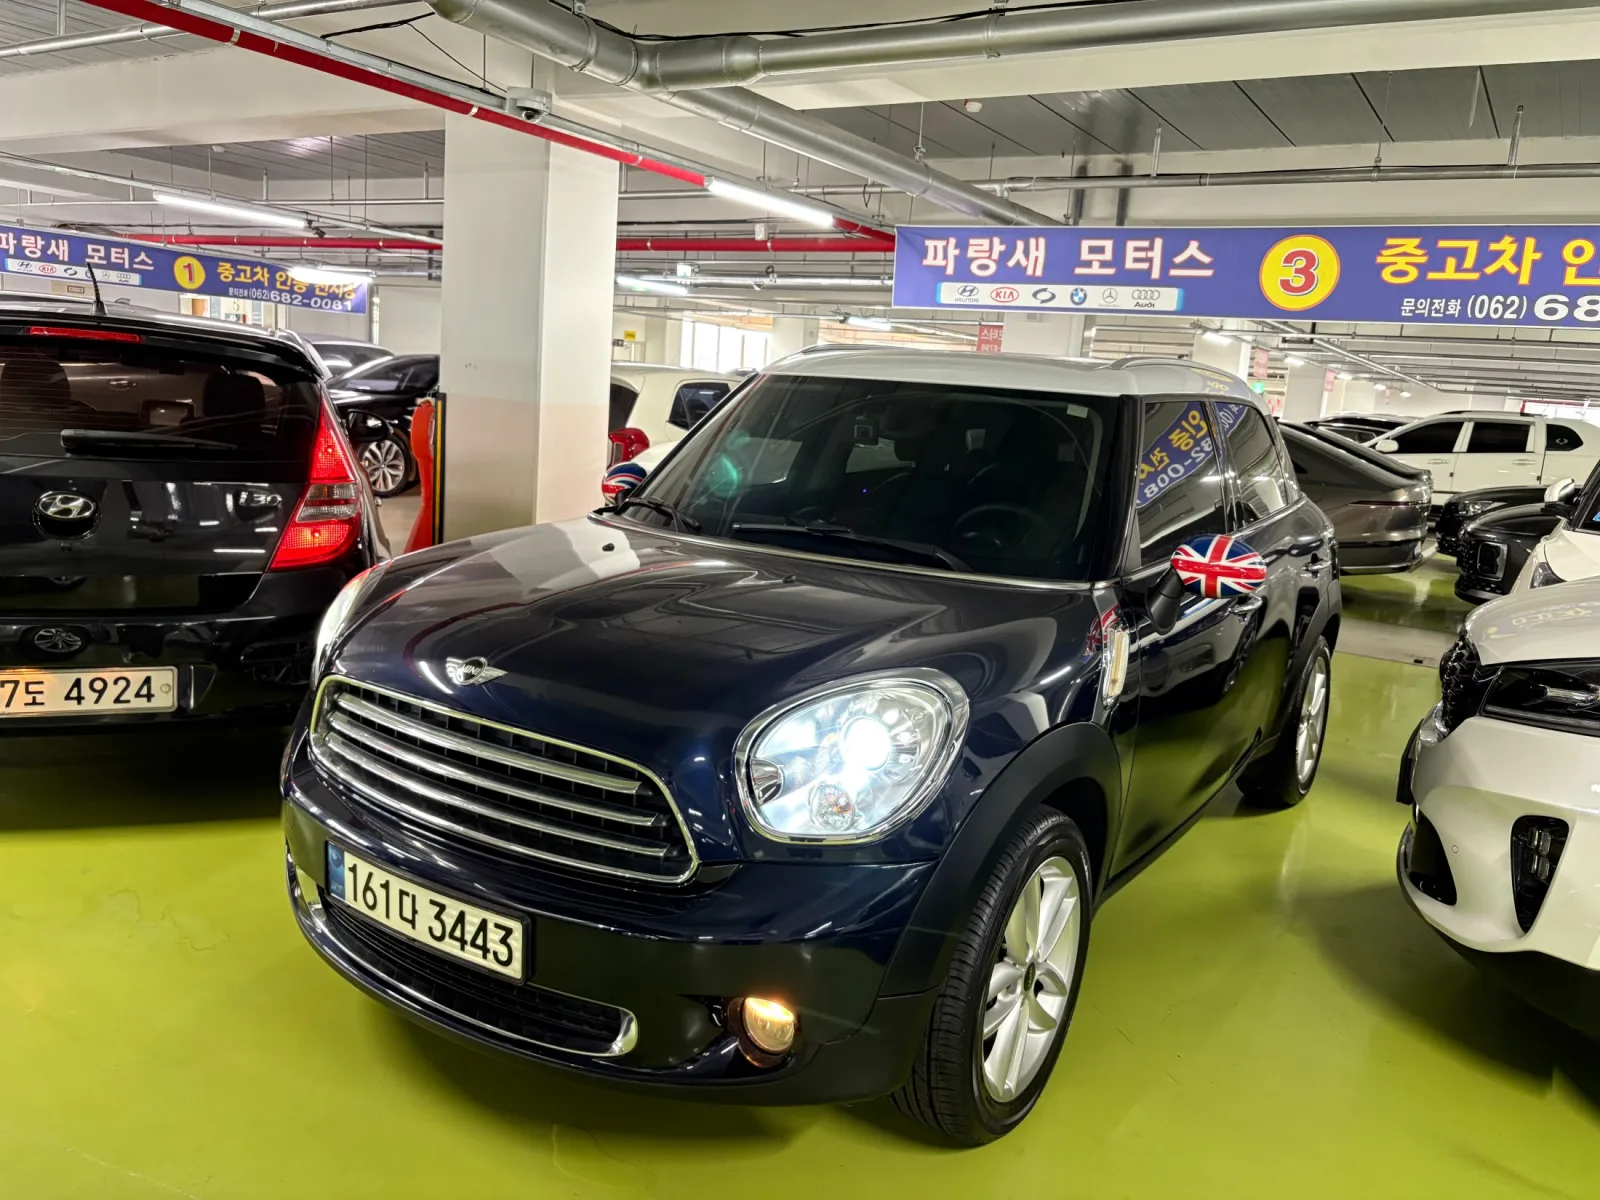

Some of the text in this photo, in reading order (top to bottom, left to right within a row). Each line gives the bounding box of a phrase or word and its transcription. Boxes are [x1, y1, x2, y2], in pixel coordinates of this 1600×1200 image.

[0, 231, 155, 271] 파랑새 모터스
[922, 236, 1215, 280] 파랑새 모터스
[1375, 234, 1543, 286] 중고차
[183, 262, 196, 284] 1
[217, 261, 269, 287] 중고차
[1278, 248, 1319, 296] 3
[270, 290, 352, 311] 682-0081
[993, 289, 1016, 301] KIA
[1400, 297, 1461, 318] 문의전화
[1467, 294, 1527, 320] (062)
[239, 491, 282, 506] i30
[461, 663, 482, 676] MINI
[64, 676, 155, 706] 4924
[348, 863, 514, 967] 161다 3443
